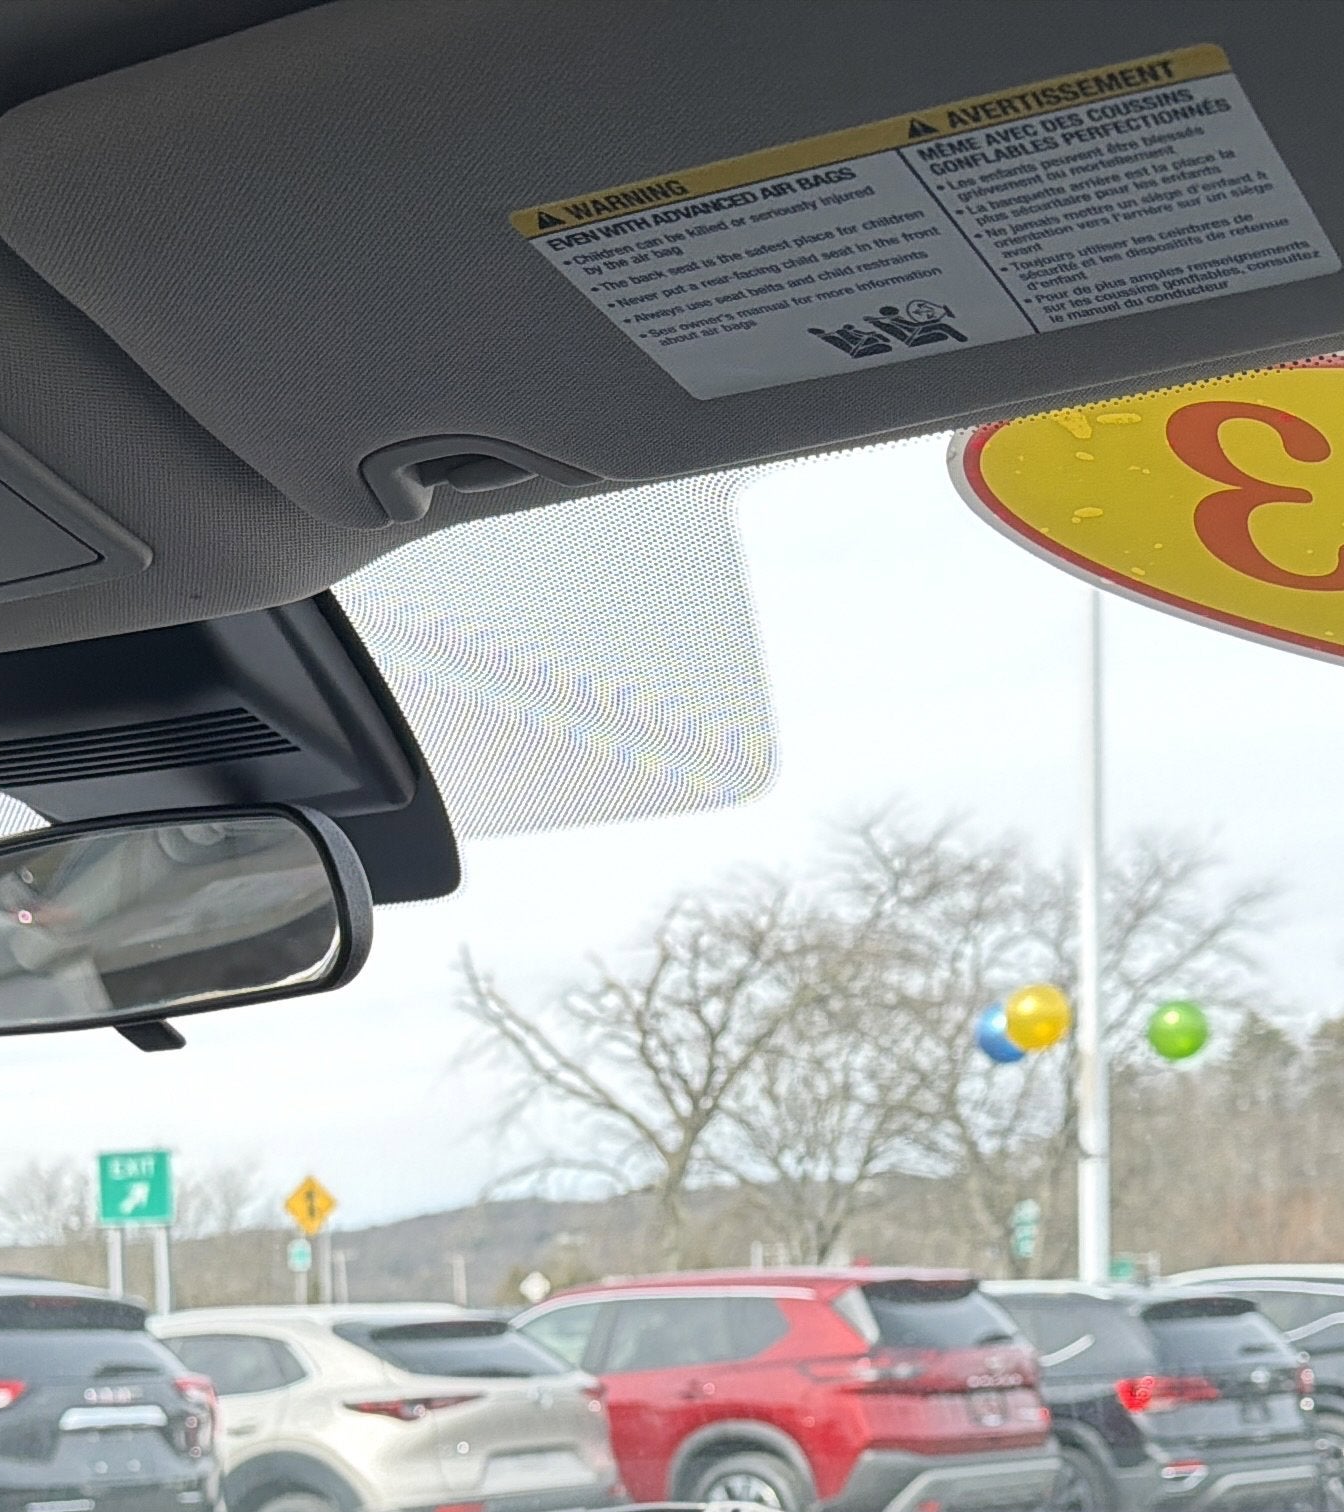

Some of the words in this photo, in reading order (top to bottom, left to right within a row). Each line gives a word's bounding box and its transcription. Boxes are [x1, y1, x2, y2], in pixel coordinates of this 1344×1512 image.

[916, 137, 980, 161] MÊME
[985, 123, 1037, 146] AVEC
[1039, 113, 1084, 132] DES
[1086, 88, 1193, 121] COUSSINS
[946, 59, 1172, 128] AVERTISSEMENT
[929, 136, 1059, 176] GONFLABLES
[1060, 98, 1231, 145] PERFECTIONNÉS
[546, 229, 600, 251] EVEN
[595, 217, 651, 238] WITH
[651, 191, 758, 225] ADVANCED
[760, 182, 797, 200] AIR
[795, 167, 856, 190] BAGS
[562, 179, 689, 220] WARNING
[572, 245, 634, 265] Children
[635, 237, 663, 249] can
[663, 233, 685, 242] be
[684, 220, 729, 237] killed
[730, 217, 746, 226] or
[748, 200, 817, 222] seriously
[818, 185, 875, 205] injured
[582, 265, 603, 275] by
[602, 258, 628, 270] the
[630, 253, 650, 263] air
[650, 246, 683, 258] bag
[598, 279, 628, 290] The
[628, 270, 667, 284] back
[667, 261, 700, 275] seat
[716, 253, 742, 263] the
[744, 239, 792, 257] safest
[791, 231, 835, 248] place
[835, 225, 857, 235] for
[861, 210, 924, 230] children
[615, 292, 658, 307] Never
[661, 284, 687, 298] put
[700, 264, 781, 287] rear-facing
[781, 253, 819, 269] child
[820, 245, 855, 259] seat
[854, 243, 872, 252] in
[872, 237, 899, 248] the
[901, 226, 940, 242] front
[1009, 251, 1075, 270] Toujours
[633, 305, 684, 322] Always
[714, 290, 747, 304] seat
[786, 274, 815, 287] and
[817, 265, 855, 280] child
[855, 251, 928, 272] restraints
[647, 326, 677, 337] See
[678, 313, 734, 330] owner's
[736, 299, 790, 317] manual
[790, 295, 811, 305] for
[814, 287, 854, 300] more
[855, 267, 942, 291] information
[1123, 298, 1143, 308] du
[658, 331, 699, 346] about
[699, 327, 719, 336] air
[720, 319, 757, 332] bags
